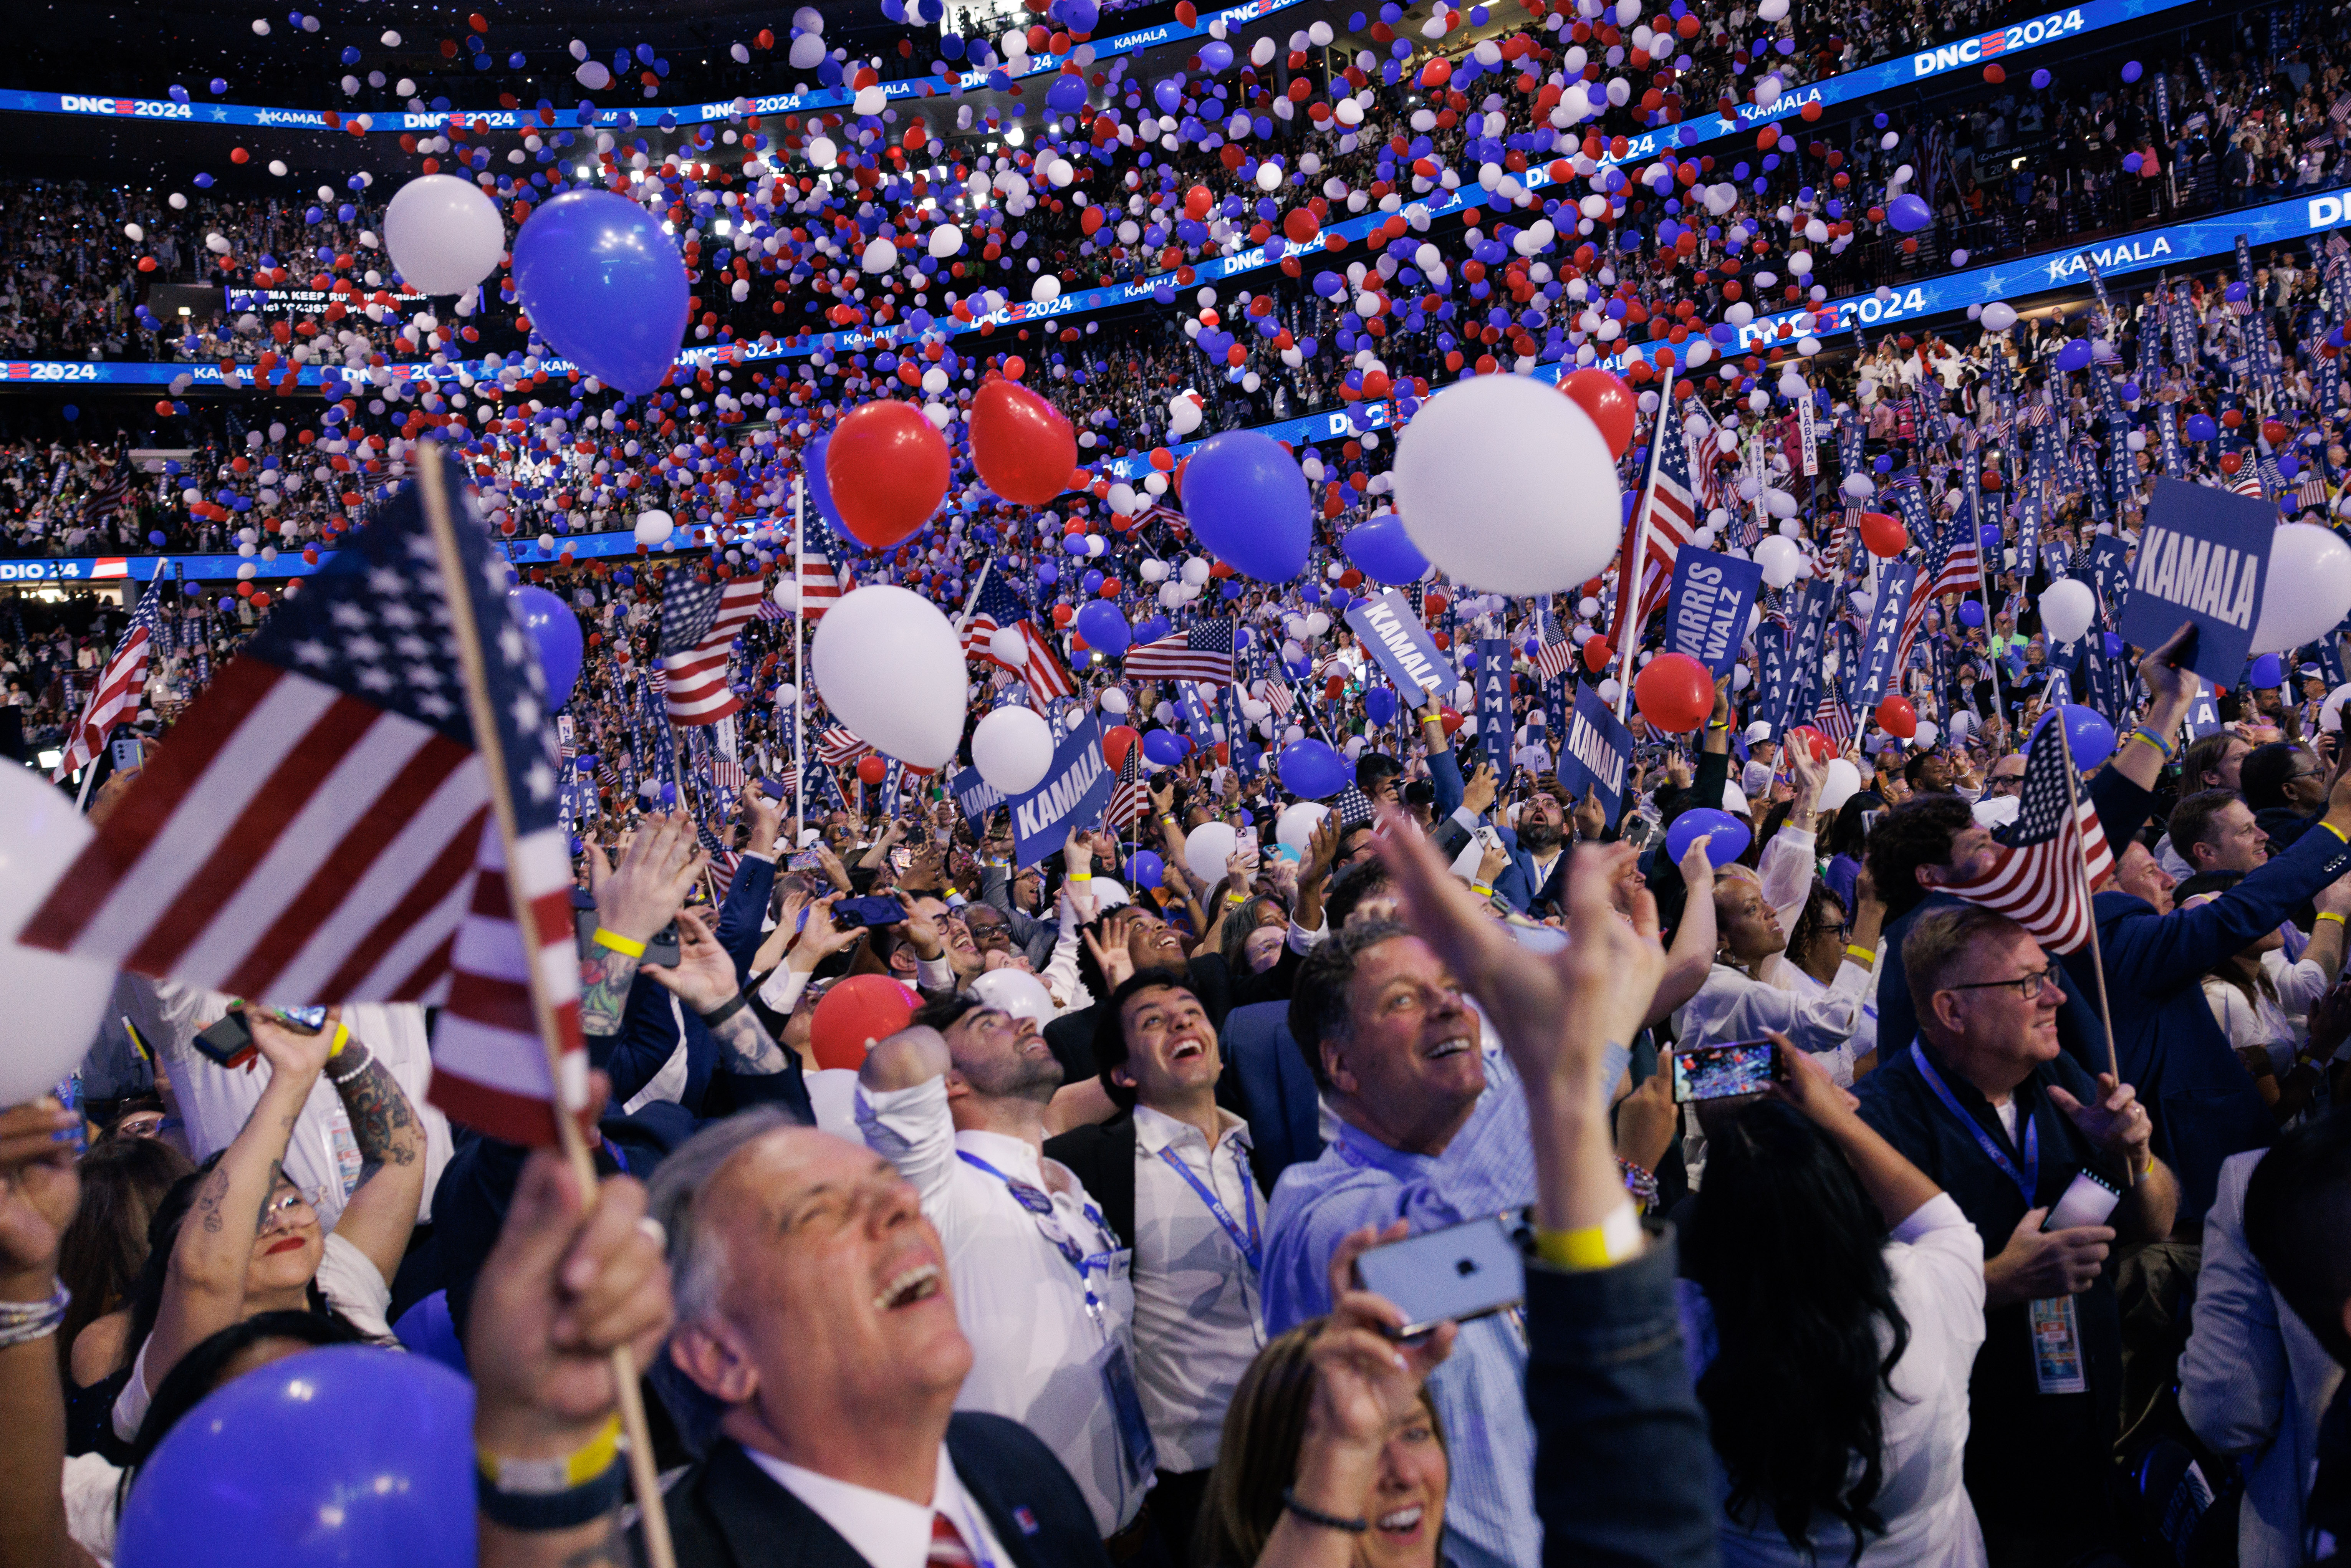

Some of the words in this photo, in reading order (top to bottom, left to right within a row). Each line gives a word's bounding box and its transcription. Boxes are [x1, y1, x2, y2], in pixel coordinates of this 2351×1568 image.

[1114, 28, 1168, 49] KAMALA
[1914, 38, 1981, 76] DNC
[2006, 9, 2084, 50] 2024
[1034, 55, 1053, 71] 24
[61, 95, 116, 114] DNC
[134, 102, 193, 118] 2024
[756, 96, 801, 113] 2024
[1742, 88, 1822, 121] KAMALA
[2158, 77, 2167, 116] KAMALA
[270, 111, 326, 125] KAMAL
[1598, 135, 1655, 166] 224
[1989, 147, 2022, 157] LEXUS
[1225, 249, 1265, 275] DNC
[2049, 236, 2172, 277] KAMALA
[2084, 255, 2104, 295] KAMALA
[2238, 240, 2251, 287] KAMALA
[291, 291, 325, 301] KEEP
[1026, 296, 1073, 319] 2024
[1839, 287, 1926, 327] 2024
[2333, 278, 2343, 320] AMALA
[843, 329, 890, 344] KAMAL
[1850, 316, 1864, 348] KAMAL
[2173, 310, 2187, 358] KAMALA
[30, 363, 98, 380] 2024
[1991, 349, 1999, 396] KAMALA
[2050, 358, 2063, 406] KAMALA
[2097, 369, 2116, 411] KAMAL
[2325, 358, 2337, 407] AMALA
[1802, 400, 1814, 463] ALABAMA
[2163, 412, 2178, 469] KAMALA
[2030, 458, 2040, 498] KAMA
[2050, 431, 2072, 487] KAMALA
[2114, 430, 2125, 493] KAMALA
[2083, 452, 2106, 512] KAMALA
[2020, 505, 2035, 568] KAMALA
[2135, 525, 2258, 630] KAMALA
[1676, 562, 1722, 659] HARRIS
[1704, 587, 1742, 659] WALZ
[1363, 600, 1442, 690] KAMALA
[1863, 580, 1906, 691] KAMALA
[2084, 632, 2109, 715] MALA
[1484, 656, 1503, 774] KAMALA
[1568, 710, 1624, 797] KAMALA
[801, 766, 825, 806] ALA
[963, 780, 1008, 820] KAMA
[1017, 739, 1103, 841] KAMALA
[1212, 1202, 1233, 1225] DNC
